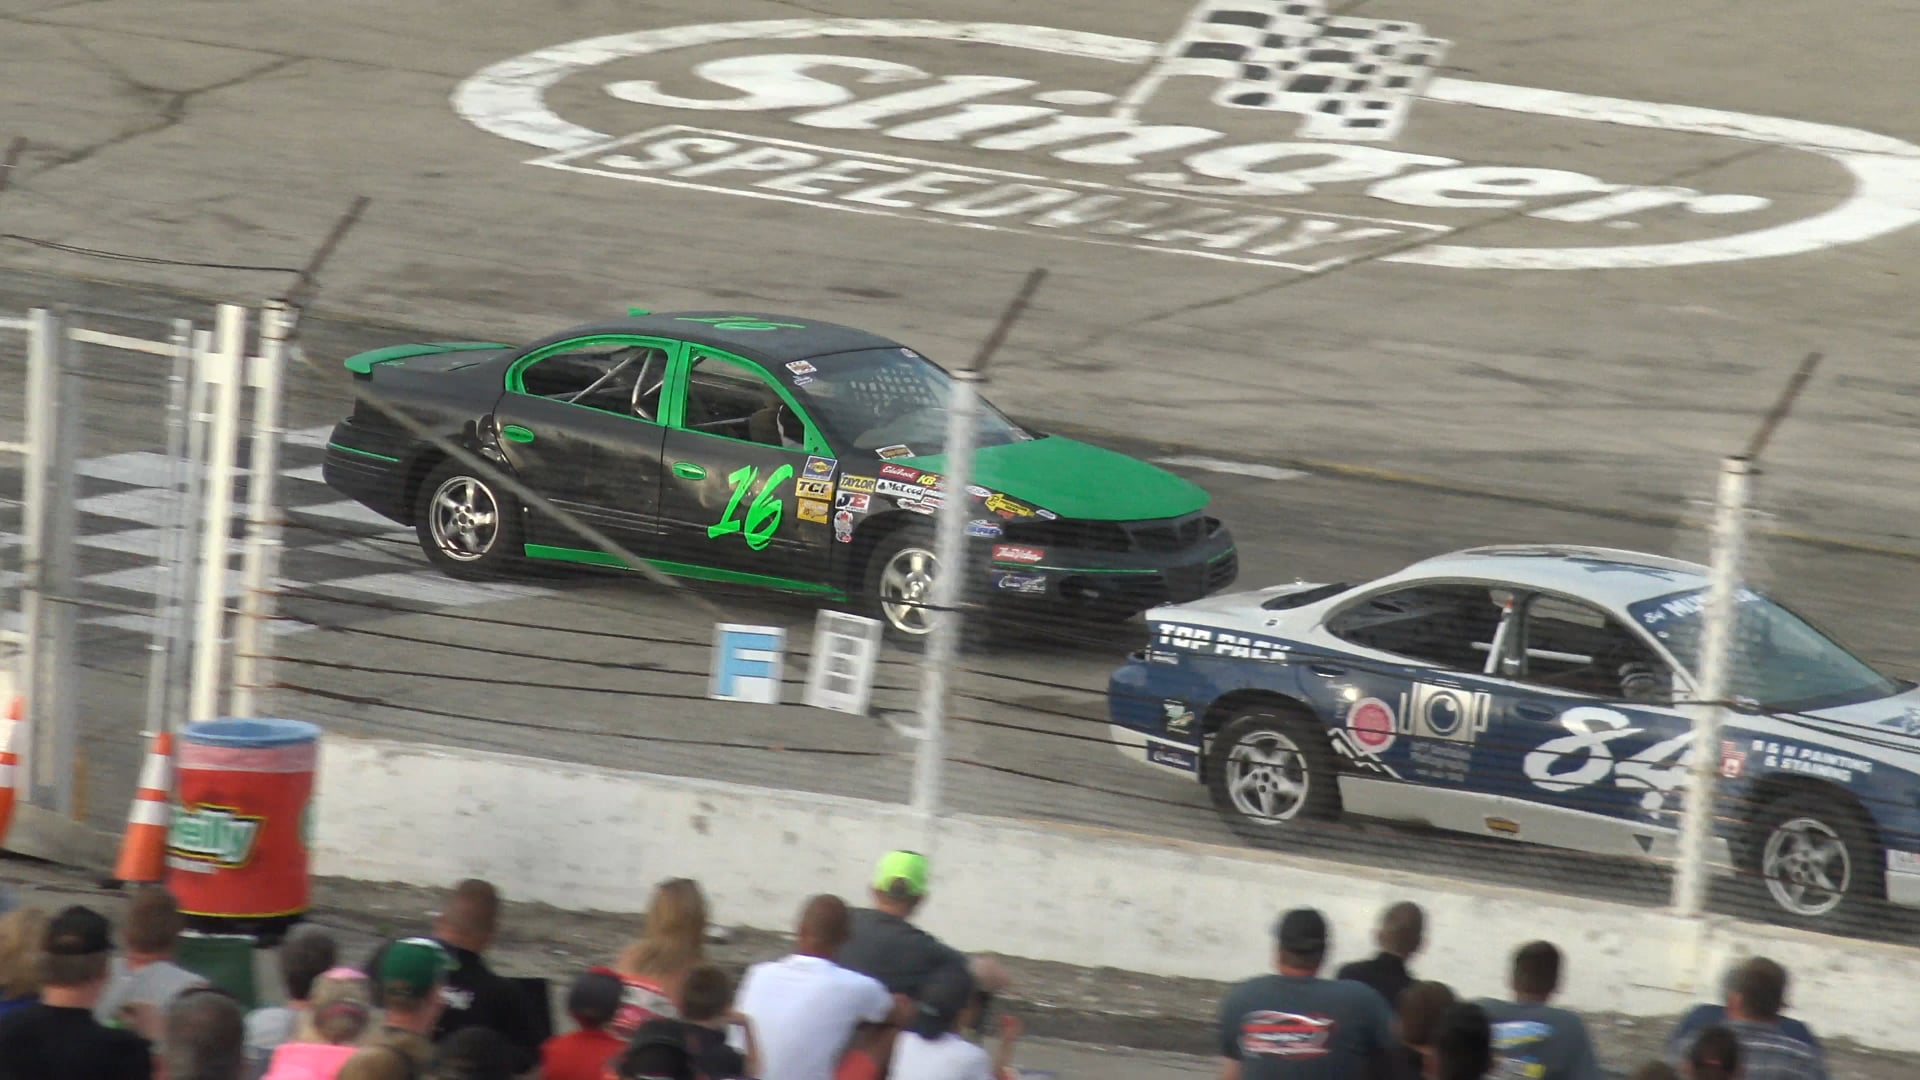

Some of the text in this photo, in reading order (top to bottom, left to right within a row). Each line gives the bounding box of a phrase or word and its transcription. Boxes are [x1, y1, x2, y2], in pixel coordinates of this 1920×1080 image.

[605, 52, 1772, 197] Slinger
[598, 136, 1406, 256] SPEEDWAY
[707, 464, 794, 551] 16
[841, 476, 875, 491] TAYLOR
[887, 482, 924, 496] McLeod
[1158, 623, 1292, 661] TOP PACK
[1523, 706, 1708, 820] 84
